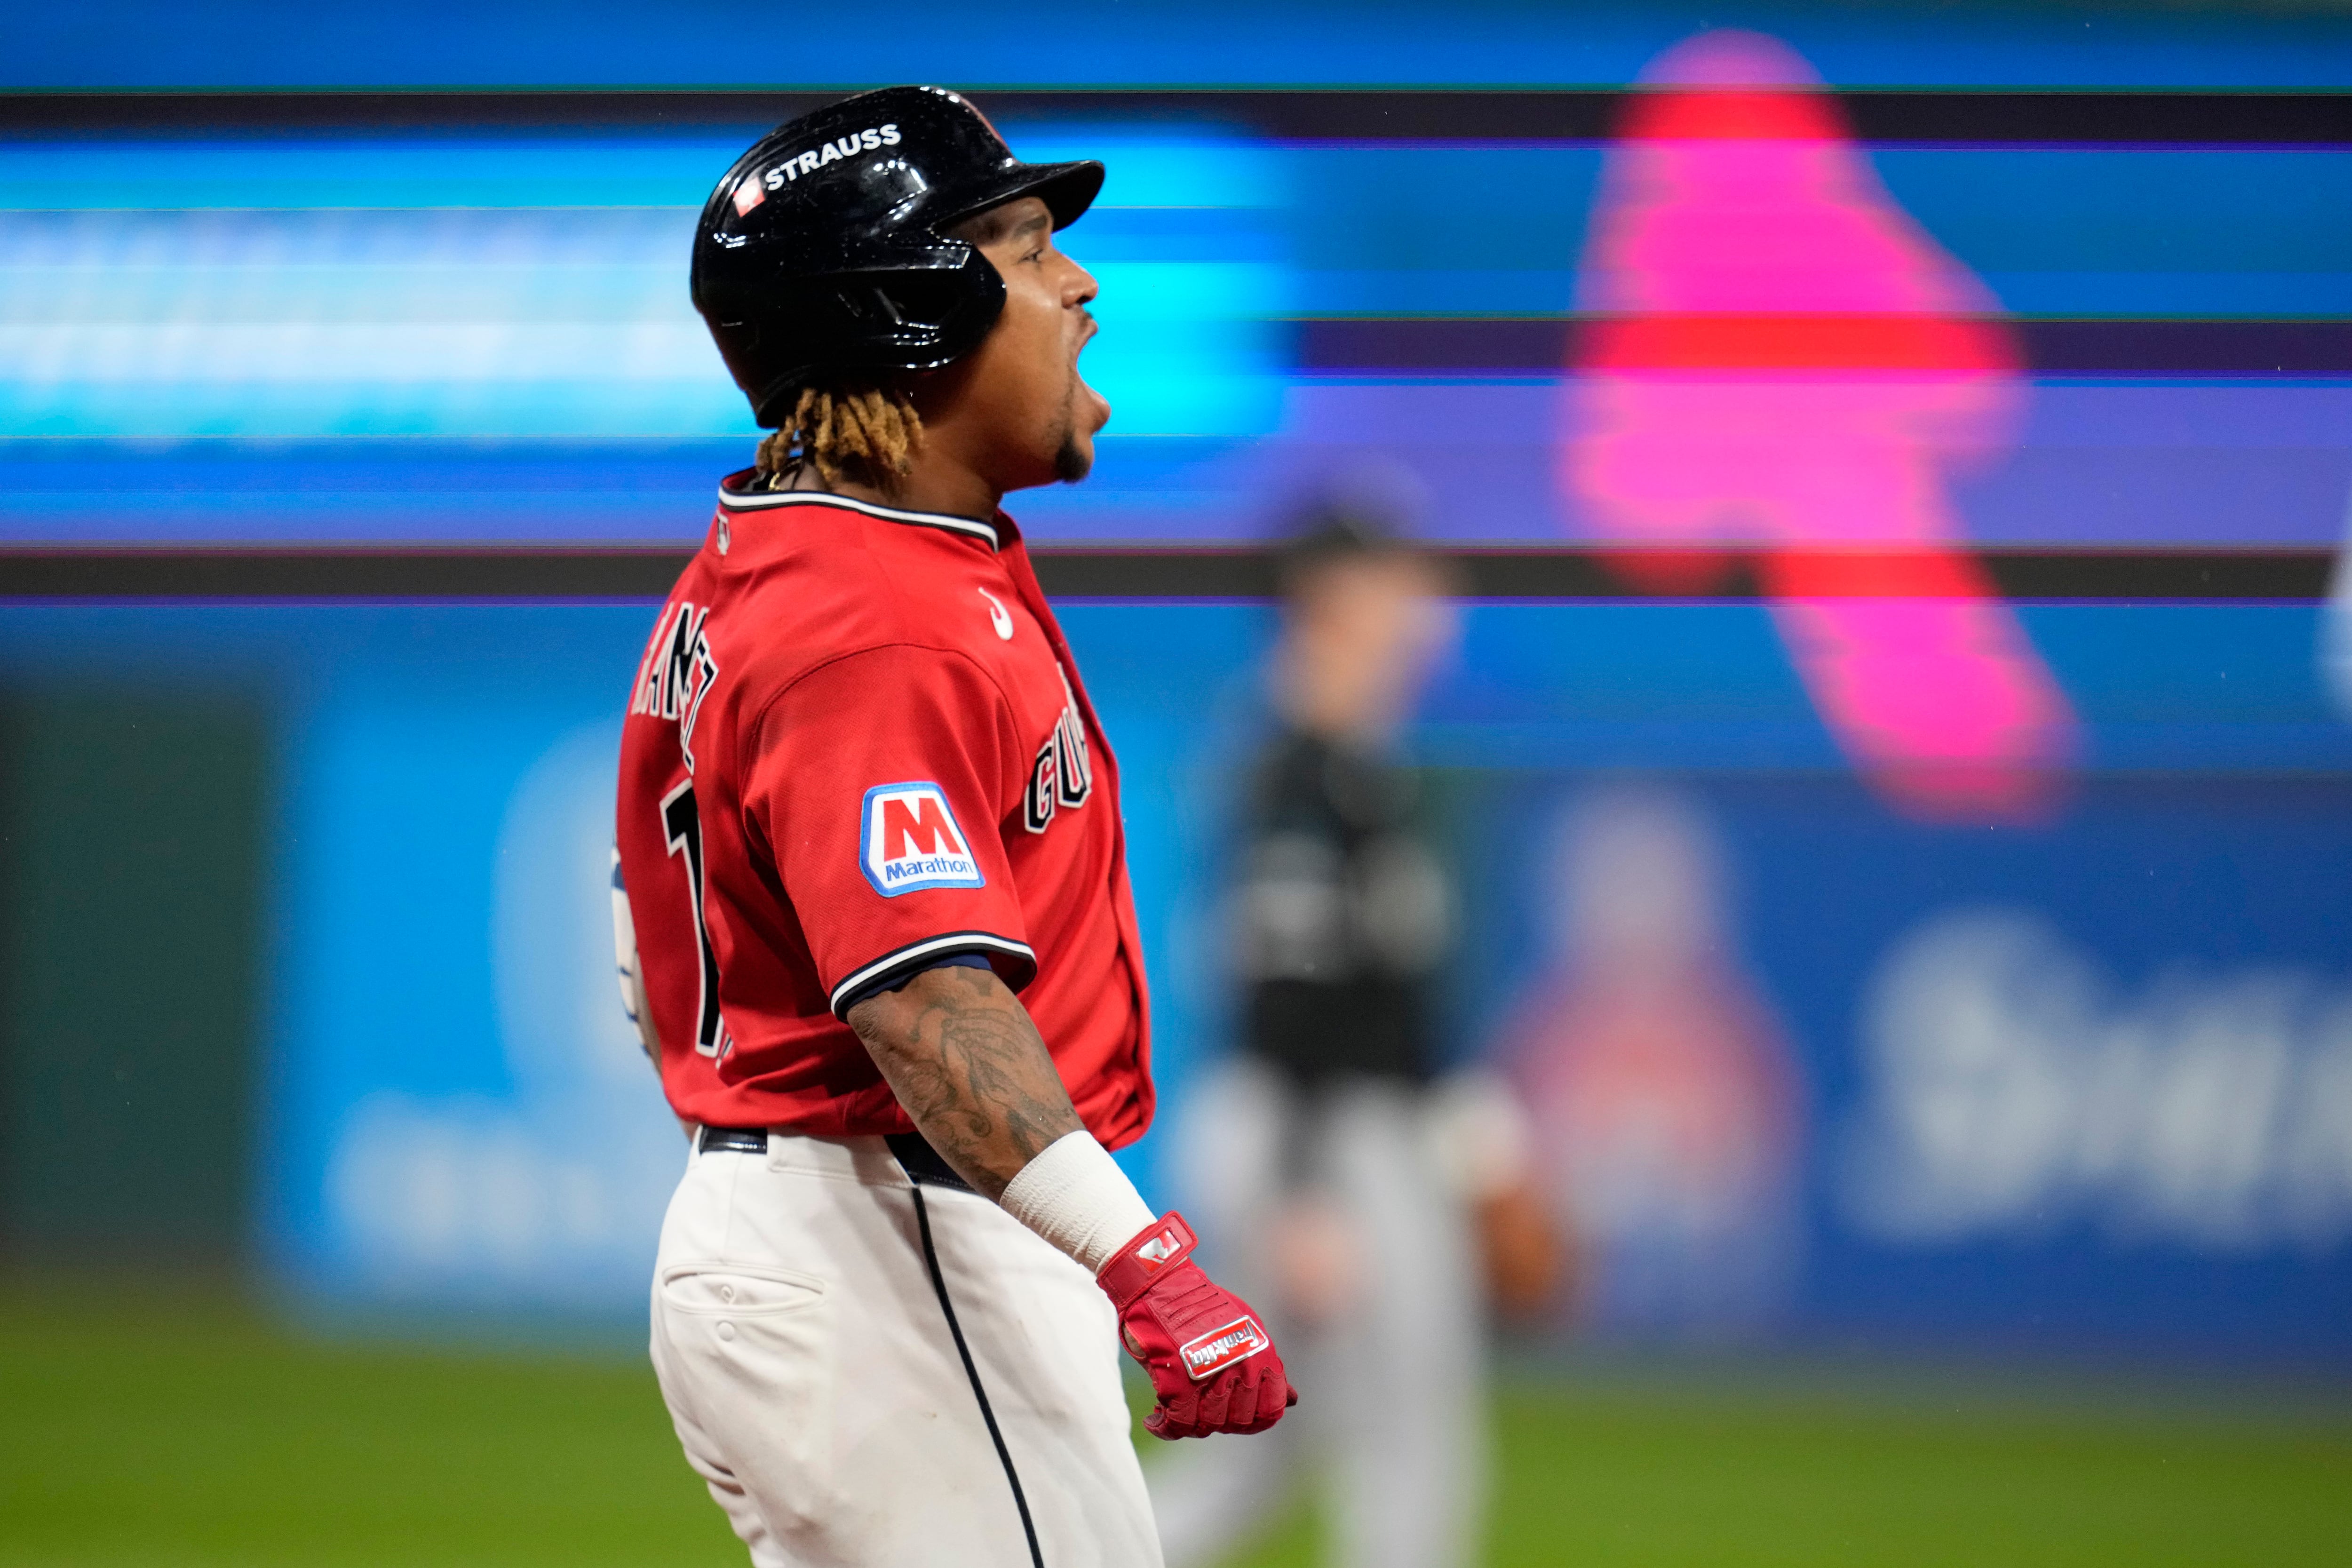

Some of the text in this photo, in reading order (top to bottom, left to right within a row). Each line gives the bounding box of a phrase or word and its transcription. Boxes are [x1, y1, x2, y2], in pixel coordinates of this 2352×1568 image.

[765, 124, 902, 191] STRAUSS
[883, 797, 964, 862] M
[885, 858, 974, 882] Marathon
[1190, 1321, 1259, 1367] Franklin
